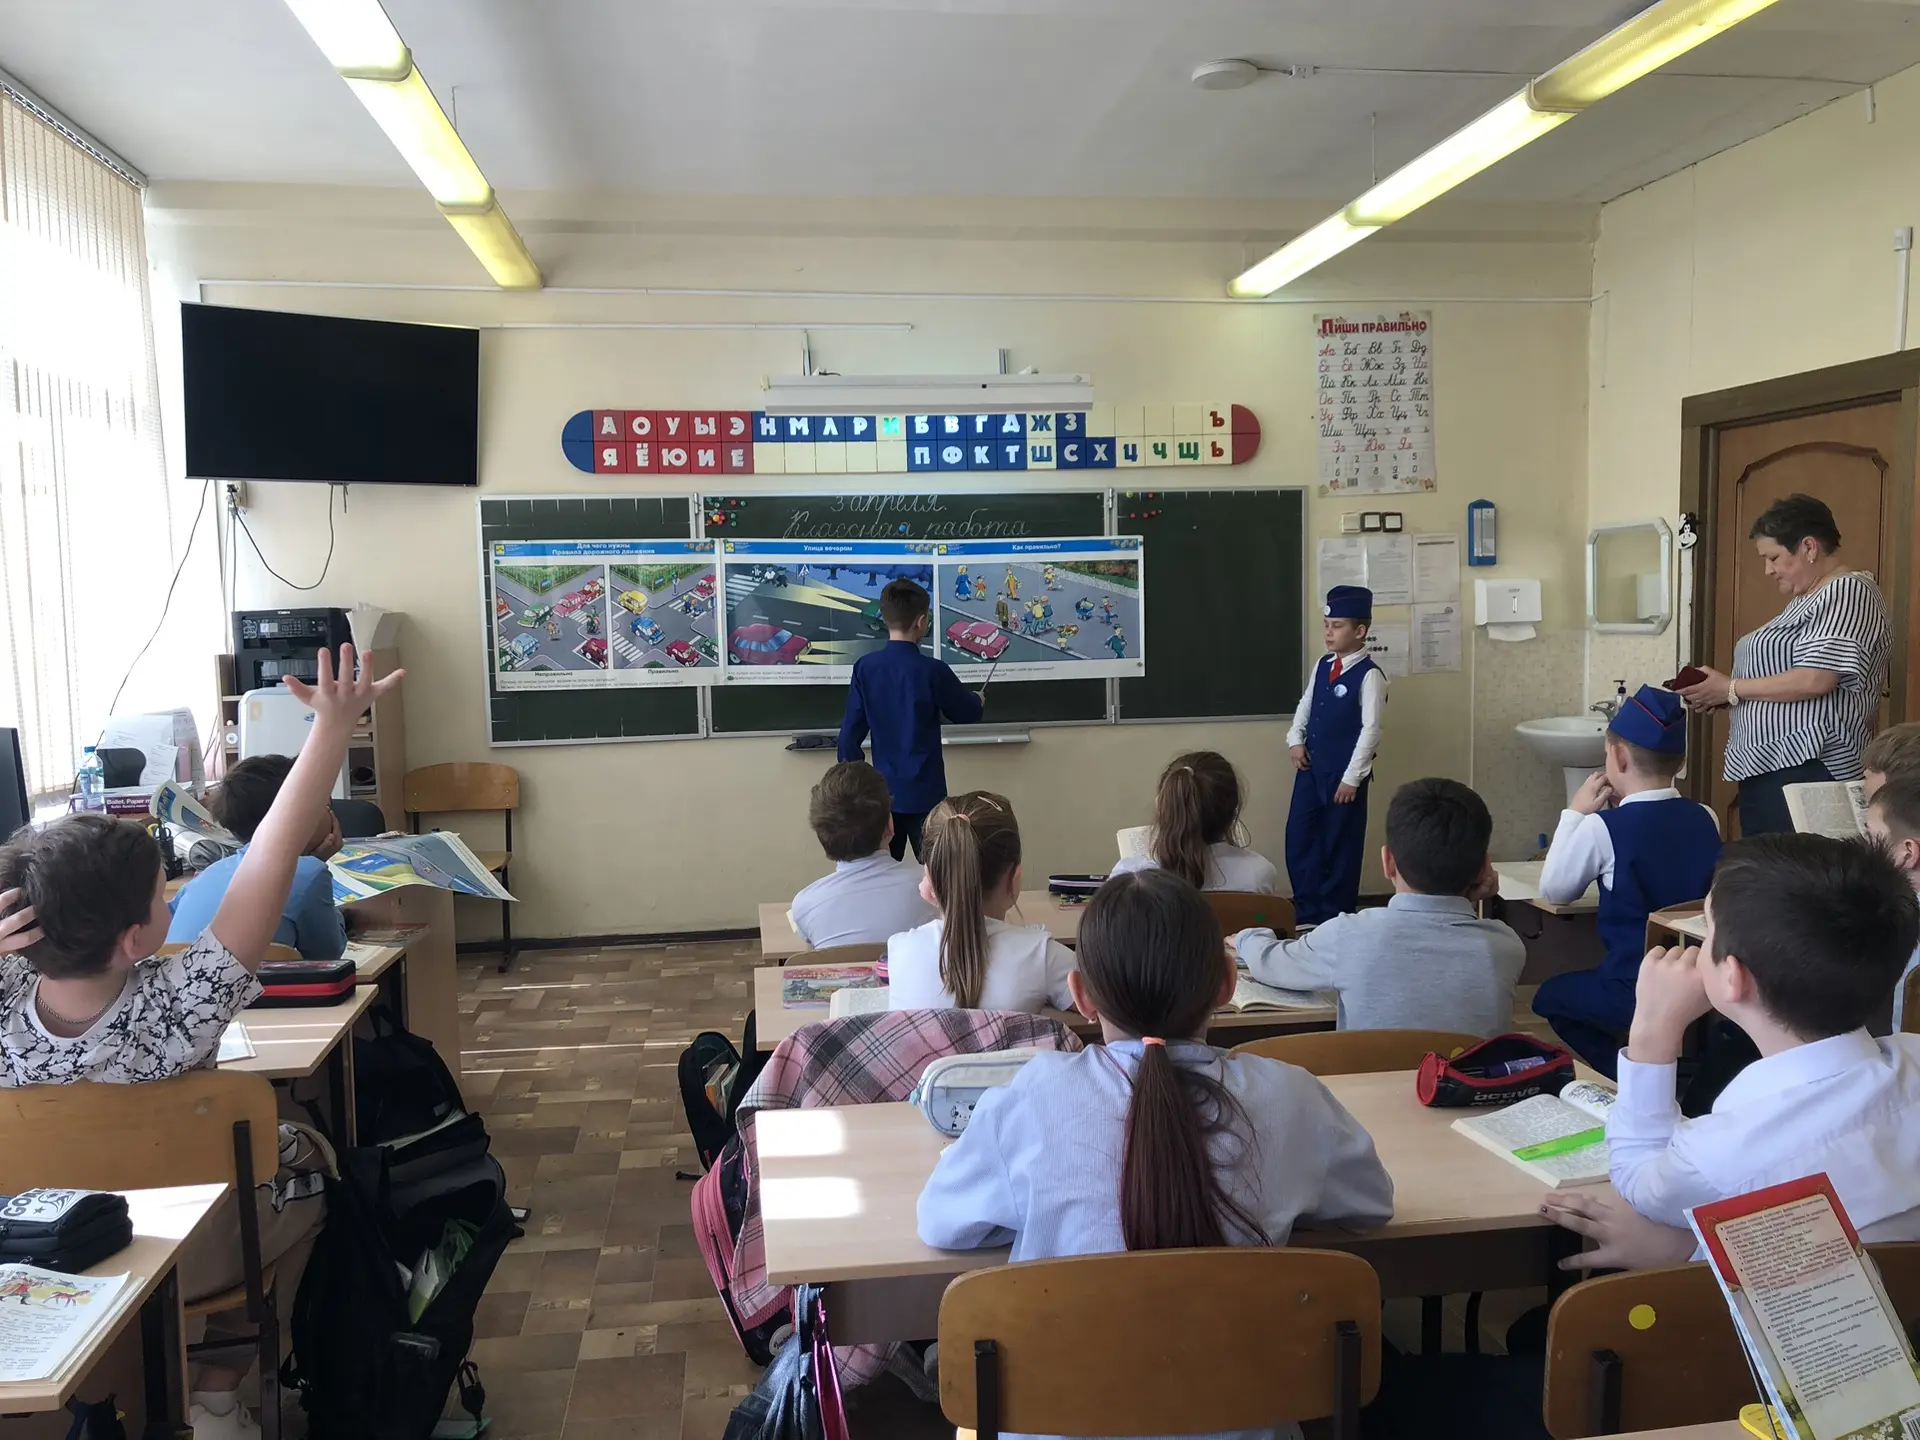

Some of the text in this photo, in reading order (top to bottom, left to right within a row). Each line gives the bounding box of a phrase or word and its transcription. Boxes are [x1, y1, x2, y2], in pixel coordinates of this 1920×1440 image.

[602, 417, 616, 434] А
[632, 417, 650, 434] О
[666, 417, 680, 434] У
[694, 417, 715, 434] Ы
[730, 417, 745, 434] Э
[760, 417, 776, 435] Н
[790, 417, 809, 435] М
[823, 417, 838, 434] Л
[853, 417, 867, 435] Р
[914, 415, 929, 433] Б
[944, 415, 959, 433] В
[976, 415, 988, 433] Г
[1003, 414, 1020, 433] Д
[1031, 415, 1051, 431] Ж
[1210, 411, 1225, 427] Ъ
[602, 442, 1224, 466] Я Ё Ю И Е П Ф К Т Ш С Х Ц Ч Щ Ь
